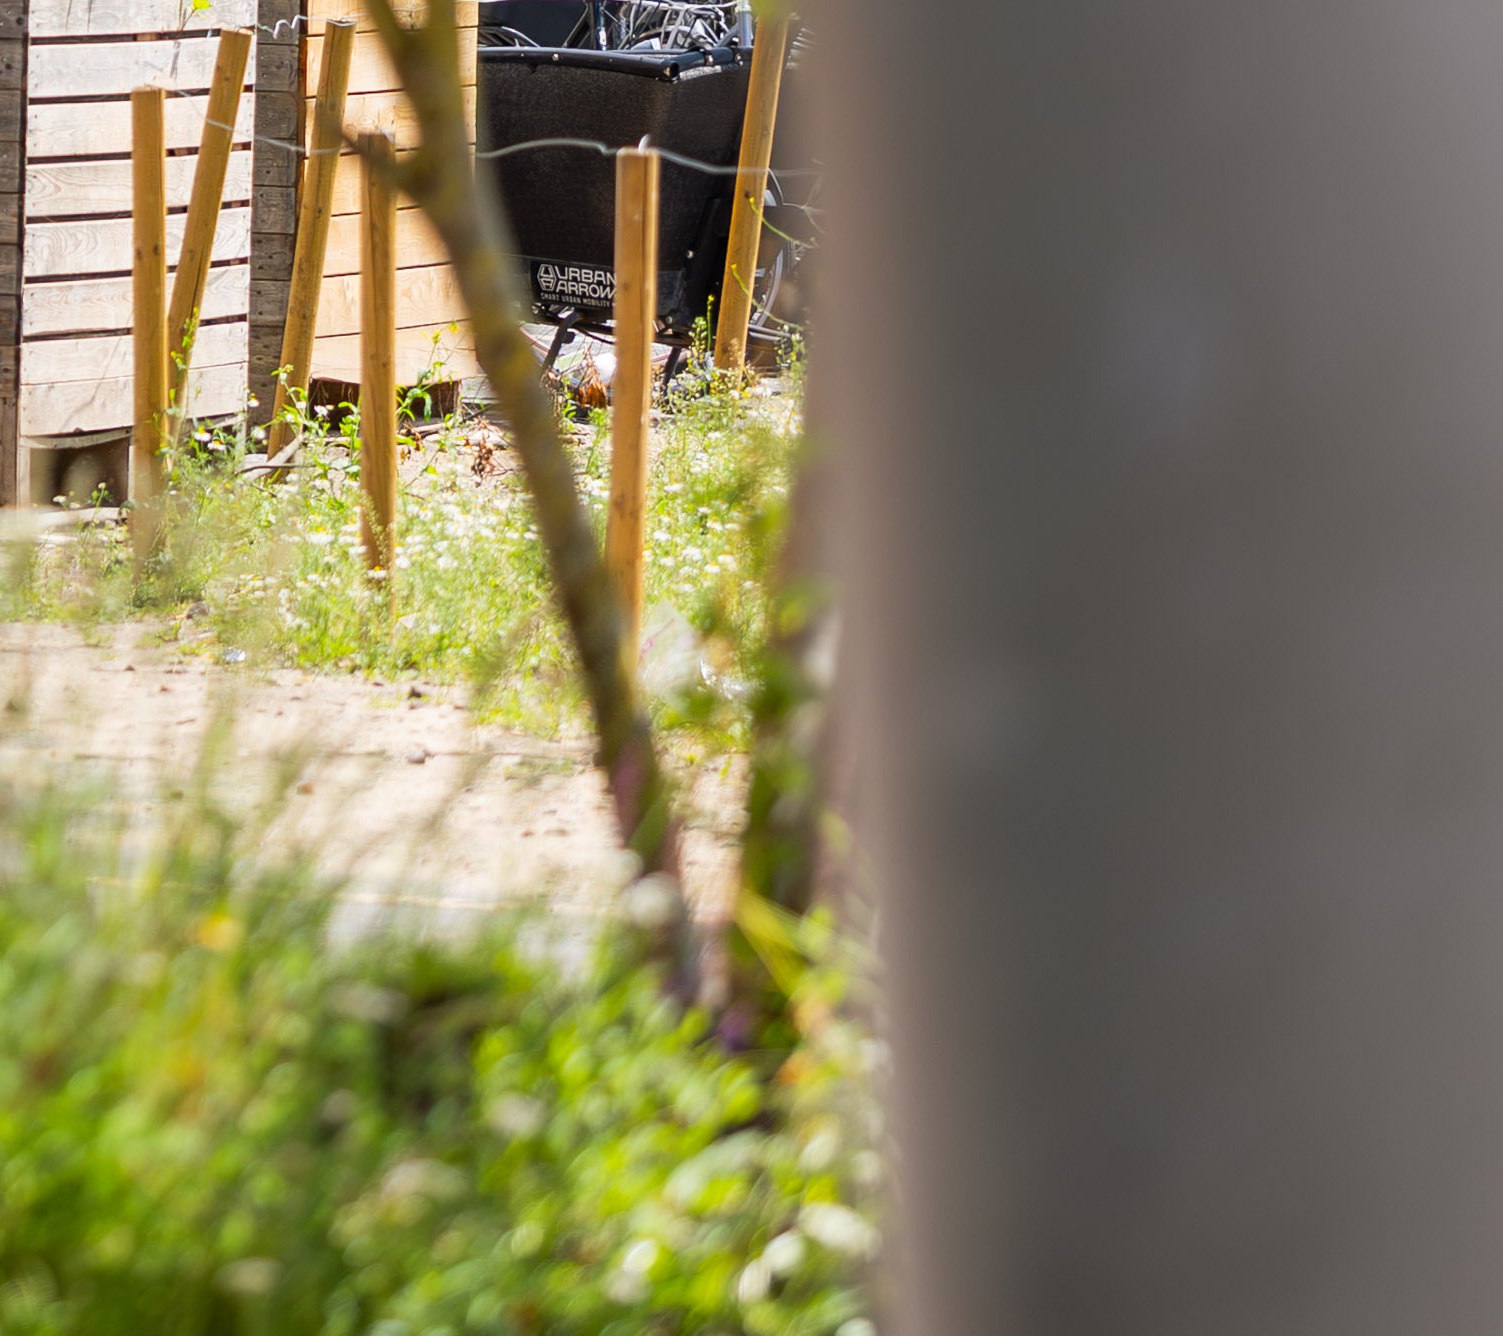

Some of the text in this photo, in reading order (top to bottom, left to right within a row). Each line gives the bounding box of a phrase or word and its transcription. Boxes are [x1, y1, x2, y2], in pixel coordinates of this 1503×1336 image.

[540, 292, 610, 308] SMART URBAN MOBILITY
